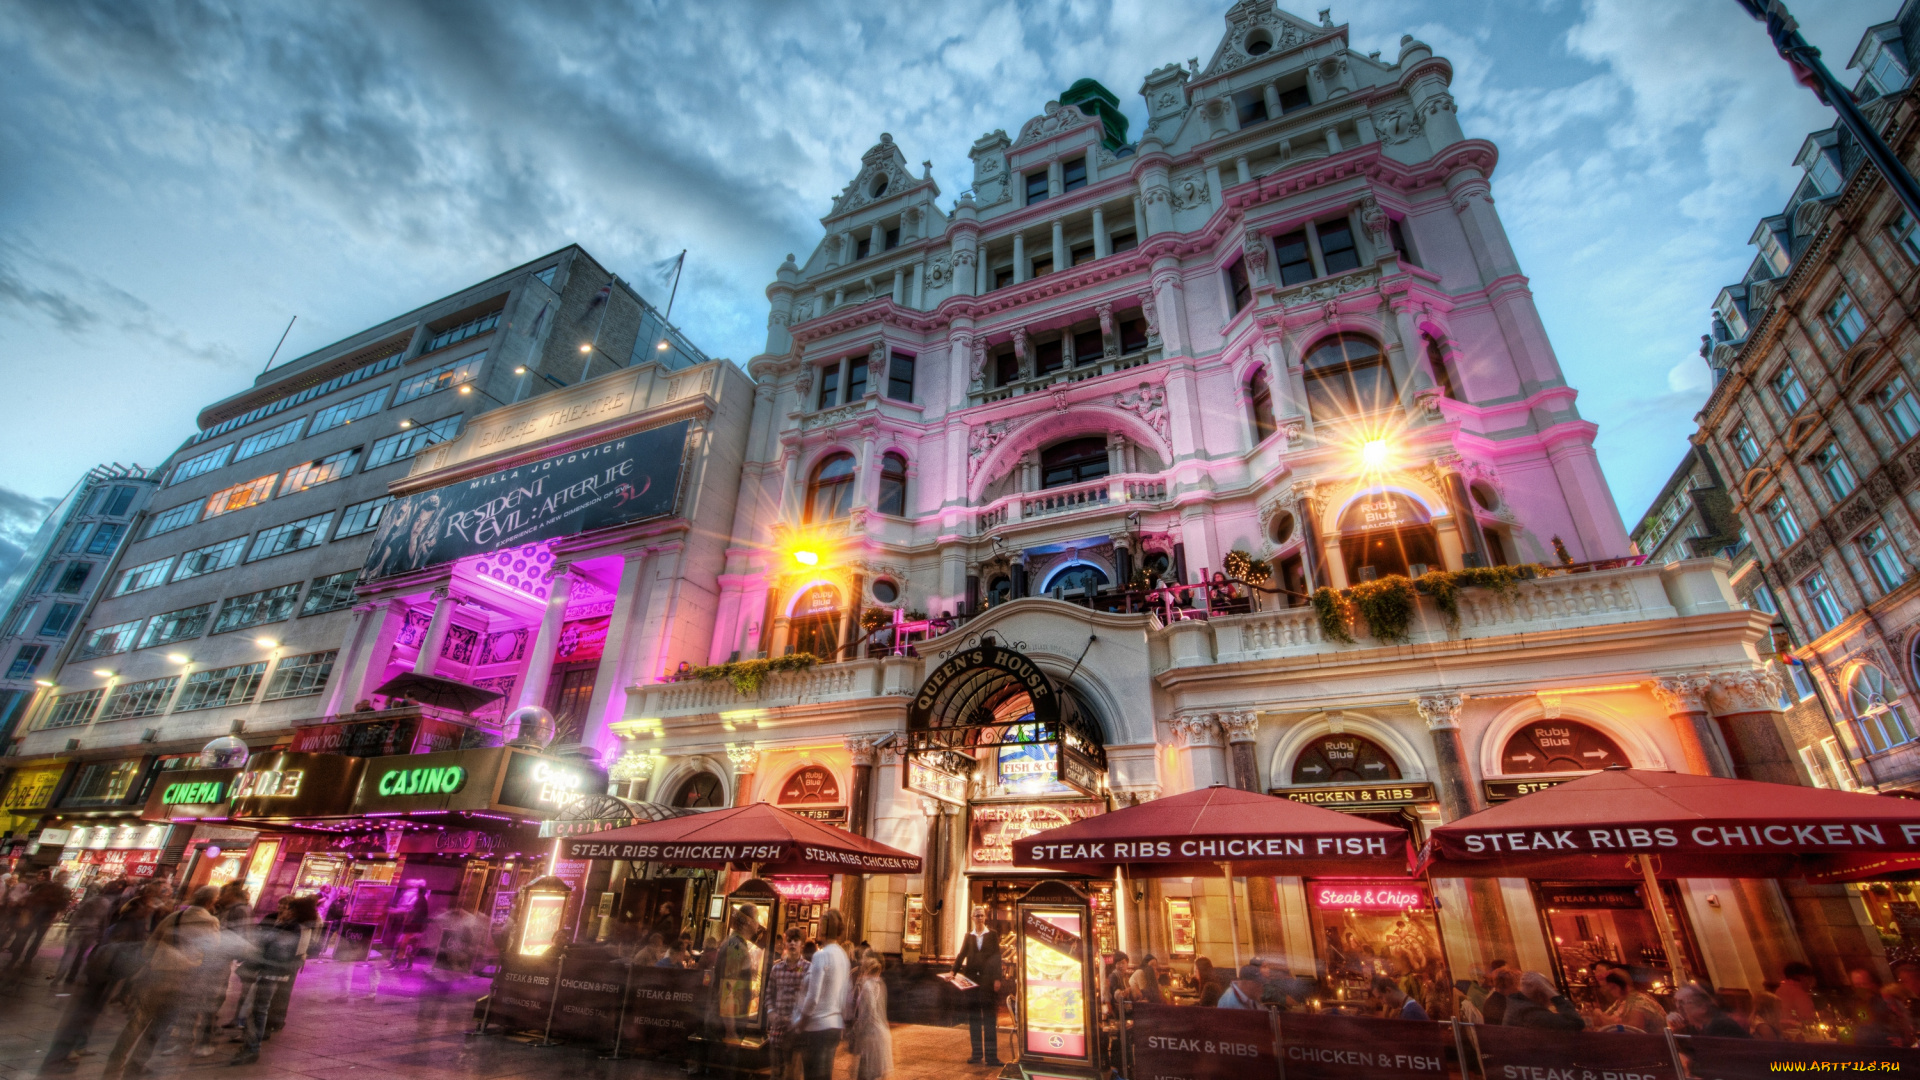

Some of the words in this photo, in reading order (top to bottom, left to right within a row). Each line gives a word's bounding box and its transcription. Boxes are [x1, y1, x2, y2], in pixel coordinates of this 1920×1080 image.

[479, 418, 539, 448] EMPIRE
[548, 392, 625, 428] THEATRE
[470, 471, 519, 490] MILLA
[531, 441, 626, 473] JOVOVICH
[538, 458, 634, 519] AFTERLIFE
[612, 474, 651, 508] 3D
[444, 475, 550, 543] RESIDENT
[1361, 500, 1397, 513] Ruby
[495, 522, 538, 548] EXPERIENCE
[546, 512, 563, 526] NEW
[563, 496, 602, 518] DIMENSION
[603, 491, 614, 499] OF
[615, 483, 632, 494] EVIL
[1365, 511, 1397, 523] Blue
[1361, 519, 1405, 531] BALCONY
[812, 599, 831, 607] Blue
[917, 650, 984, 710] QUEEN'S
[995, 650, 1048, 699] HOUSE
[1534, 727, 1570, 738] Ruby
[422, 732, 452, 750] WSOP
[1325, 741, 1354, 751] Ruby
[1540, 738, 1571, 747] Blue
[1328, 751, 1354, 760] Blue
[1004, 763, 1030, 773] FISH
[1033, 761, 1042, 772] &
[378, 765, 464, 797] CASINO
[805, 772, 823, 780] Ruby
[162, 782, 224, 804] CINEMA
[1517, 782, 1558, 794] STE
[1289, 791, 1356, 803] CHICKEN
[1361, 791, 1371, 800] &
[1376, 789, 1413, 800] RIBS
[808, 810, 829, 819] FISH
[556, 822, 612, 834] CASINO
[1008, 822, 1066, 830] RESTAURANT
[1464, 830, 1579, 854] STEAK
[1586, 827, 1680, 849] RIBS
[1691, 824, 1887, 847] CHICKEN
[571, 843, 618, 858] STEAK
[622, 844, 659, 859] RIBS
[662, 845, 736, 860] CHICKEN
[740, 845, 781, 859] FISH
[1031, 844, 1105, 861] STEAK
[1113, 841, 1171, 858] RIBS
[1180, 838, 1306, 857] CHICKEN
[1317, 836, 1388, 855] FISH
[104, 850, 128, 864] SALE
[805, 847, 840, 864] STEAK
[839, 850, 862, 866] RIBS
[862, 854, 902, 869] CHICKEN
[900, 857, 919, 871] FISH
[136, 864, 154, 876] 50%
[795, 884, 802, 895] &
[802, 883, 828, 897] Chips
[1319, 889, 1362, 905] Steak
[1363, 890, 1375, 905] &
[1376, 889, 1418, 908] Chips
[1553, 895, 1586, 903] STEAK
[1027, 916, 1056, 936] 2-For-1
[505, 972, 527, 983] STEAK
[527, 975, 532, 984] &
[532, 975, 550, 986] RIBS
[561, 978, 594, 991] CHICKEN
[594, 982, 602, 990] &
[602, 982, 620, 994] FISH
[636, 988, 664, 1000] STEAK
[665, 991, 672, 1000] &
[673, 991, 694, 1003] RIBS
[634, 1015, 670, 1028] MERMAIDS
[1148, 1036, 1200, 1051] STEAK
[1204, 1040, 1216, 1053] &
[1219, 1041, 1258, 1057] RIBS
[1288, 1046, 1373, 1066] CHICKEN
[1378, 1053, 1391, 1067] &
[1395, 1055, 1441, 1071] FISH
[1503, 1064, 1574, 1080] STEAK
